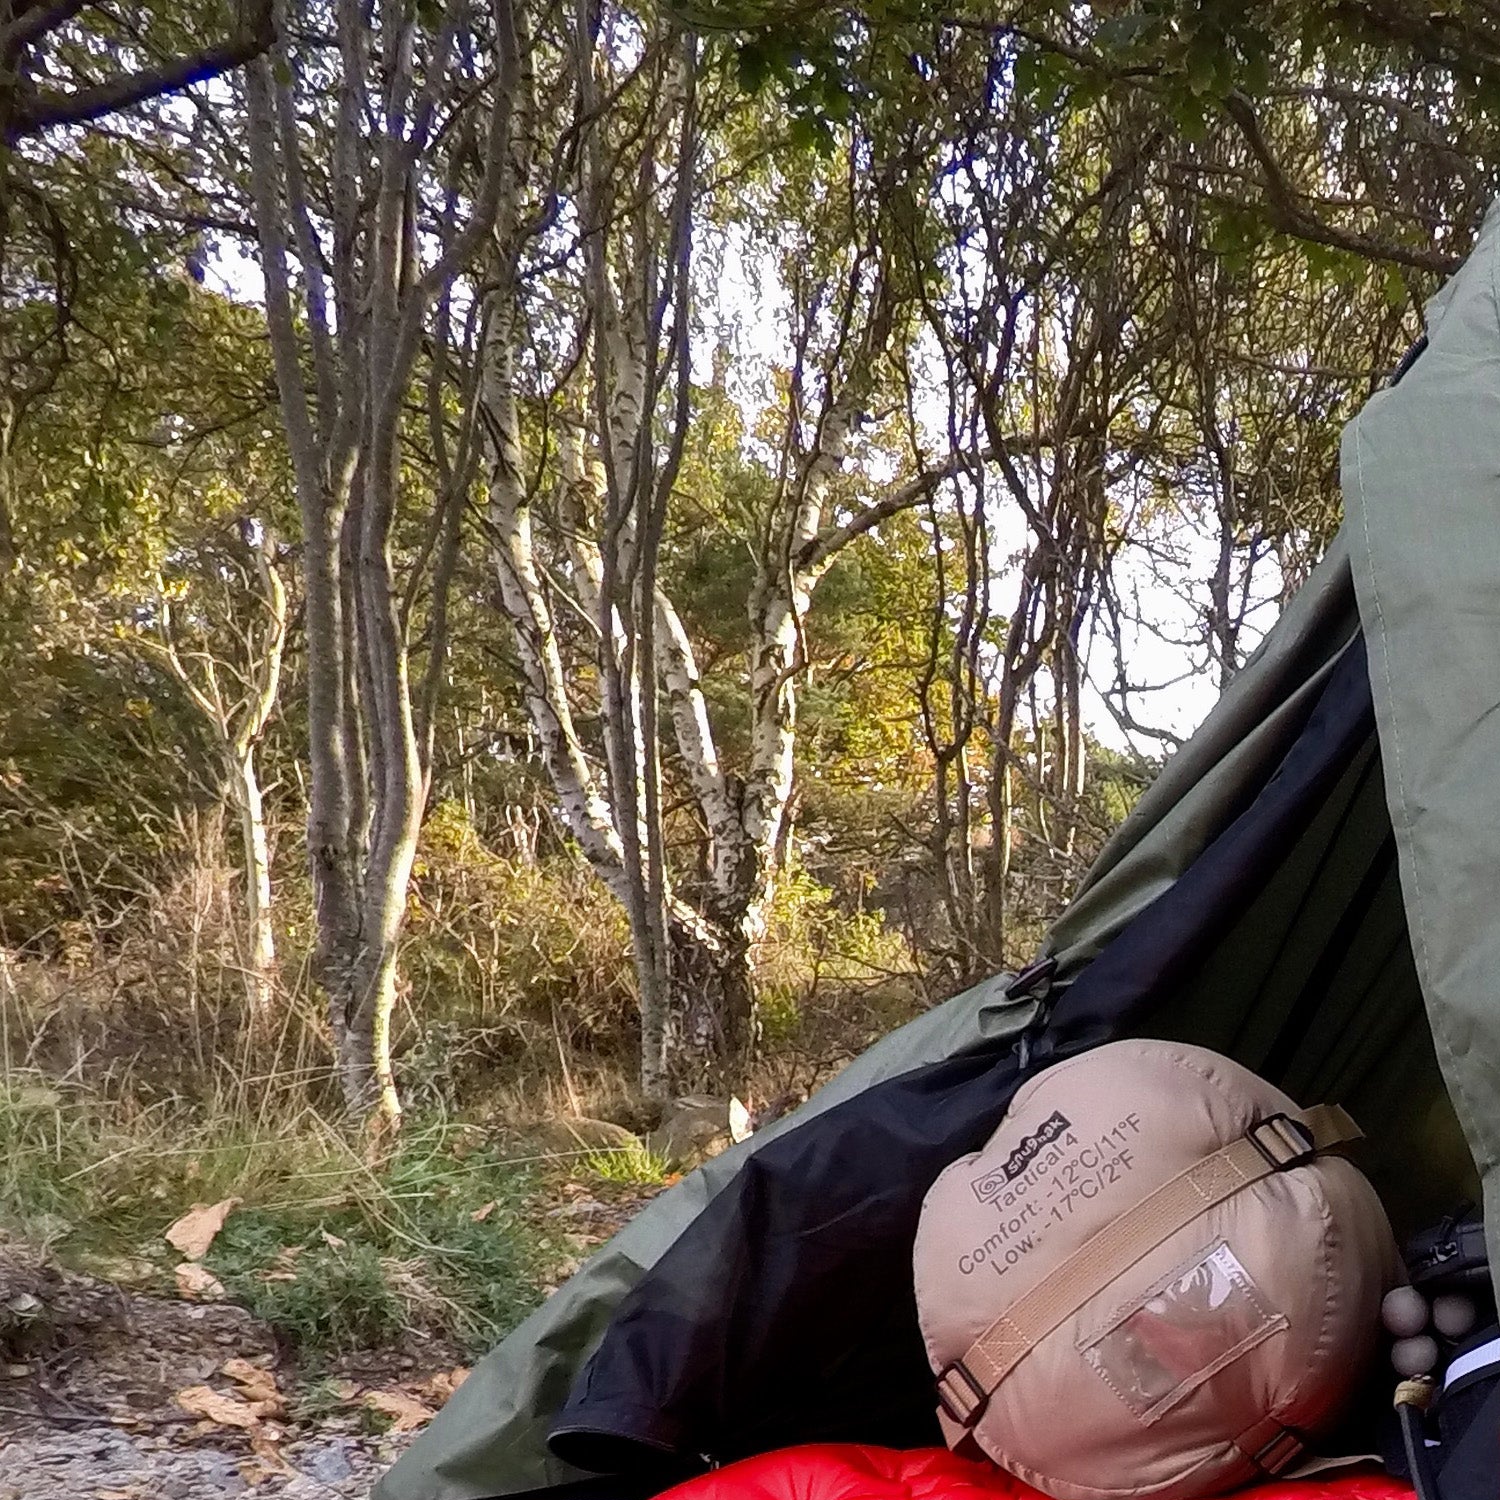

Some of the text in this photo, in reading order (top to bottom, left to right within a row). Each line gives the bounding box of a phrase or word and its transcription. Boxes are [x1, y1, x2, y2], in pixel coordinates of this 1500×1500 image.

[989, 1132, 1079, 1212] Tactical 4
[958, 1199, 1044, 1275] Comfort:
[991, 1229, 1042, 1275] Low:
